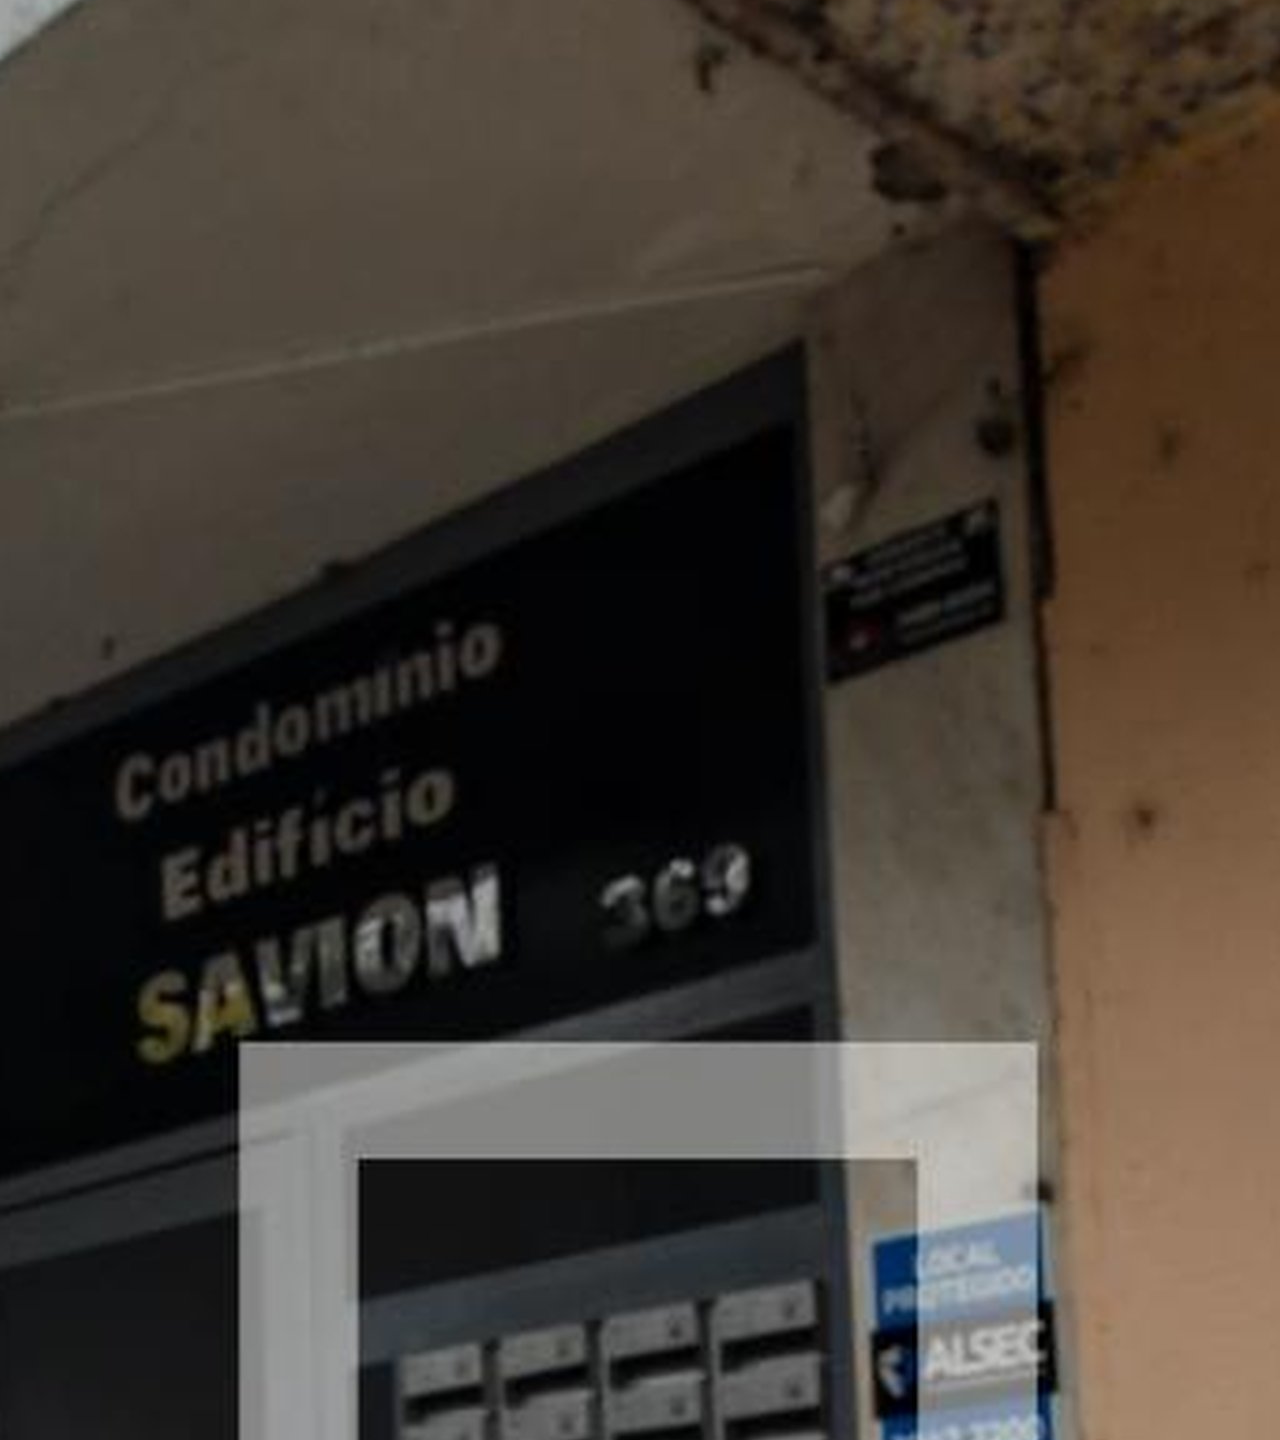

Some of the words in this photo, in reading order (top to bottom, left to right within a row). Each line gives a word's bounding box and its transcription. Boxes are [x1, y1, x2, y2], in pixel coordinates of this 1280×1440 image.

[135, 863, 503, 1064] SAVION
[599, 843, 753, 950] 369
[924, 1319, 1046, 1380] ALSEC
